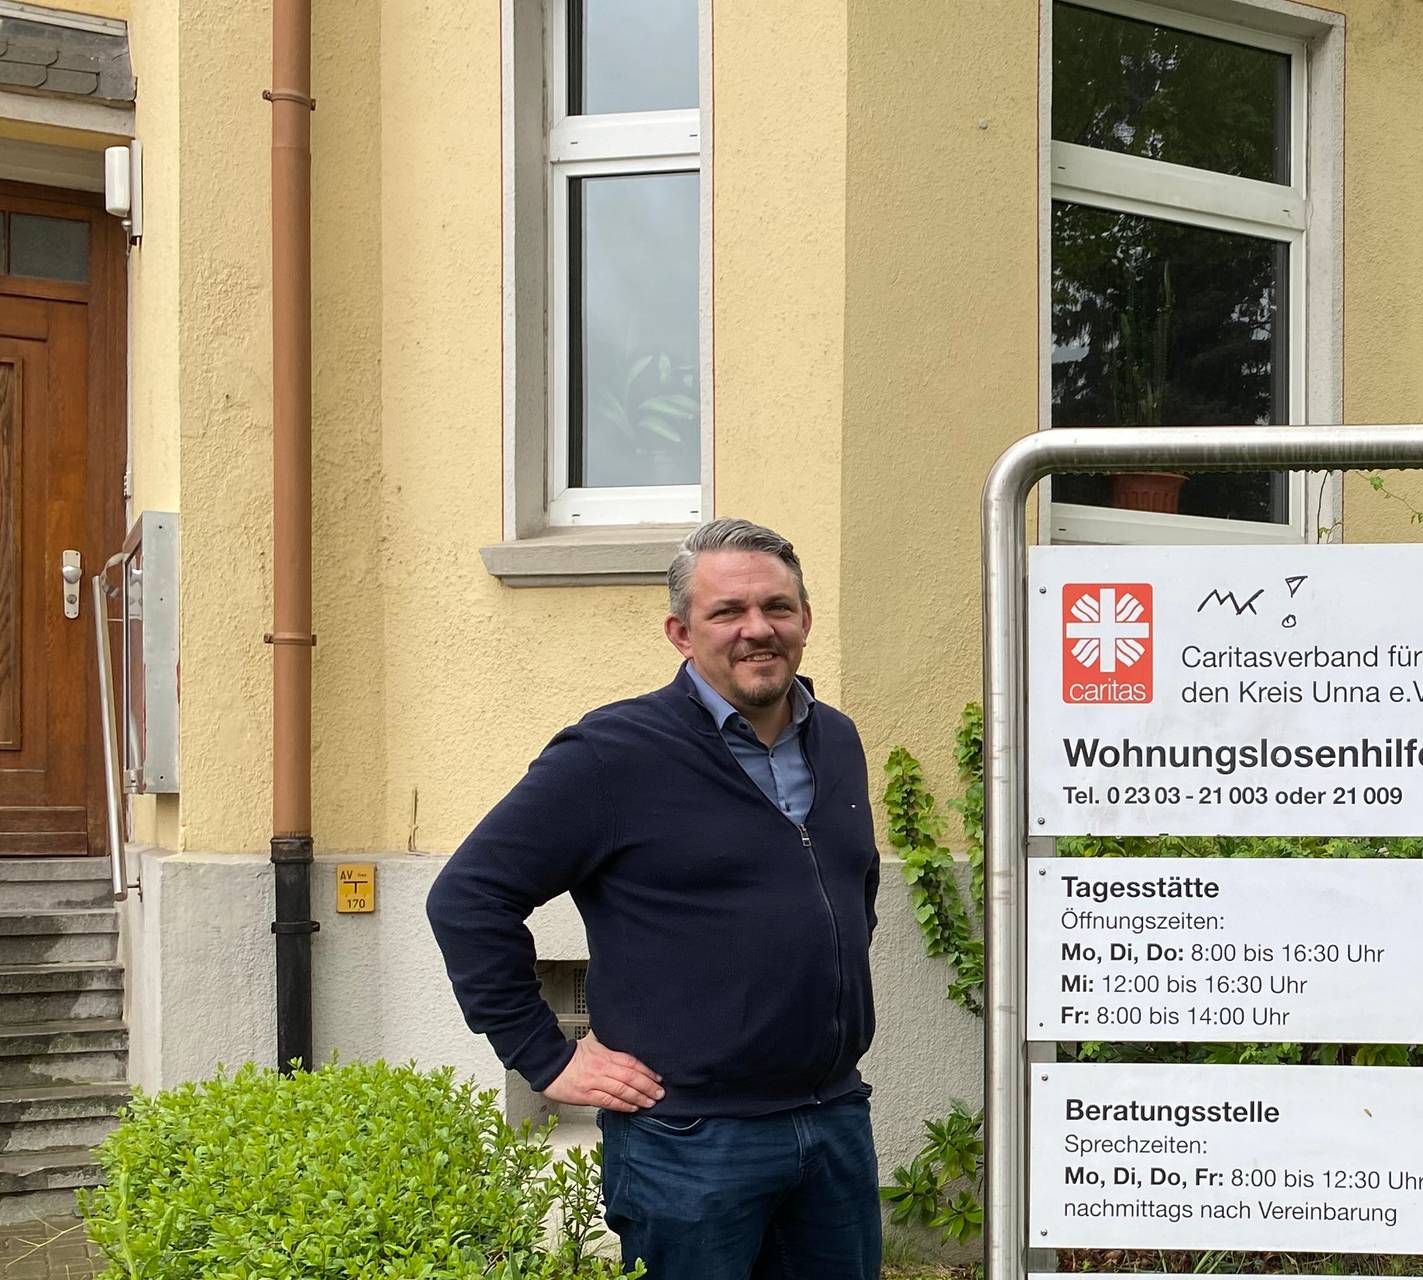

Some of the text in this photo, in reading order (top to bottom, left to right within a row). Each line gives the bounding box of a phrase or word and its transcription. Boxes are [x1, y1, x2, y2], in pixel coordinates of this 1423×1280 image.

[1181, 644, 1423, 668] Caritasverband für
[1068, 678, 1147, 703] caritas
[1181, 680, 1229, 704] den
[1239, 680, 1303, 704] Kreis
[1312, 680, 1381, 704] Unna
[1062, 786, 1100, 805] Tel.
[1275, 786, 1327, 805] oder
[1060, 875, 1220, 902] Tagesstätte
[347, 898, 366, 909] 170
[1061, 908, 1225, 933] Öffnungszeiten:
[1061, 942, 1385, 965] Mo, Di, Do: 8:00 bis 16:30 Uhr
[1061, 974, 1308, 994] Mi: 12:00 bis 16:30 Uhr
[1061, 1006, 1291, 1026] Fr: 8:00 bis 14:00 Uhr
[1065, 1098, 1281, 1126] Beratungsstelle
[1064, 1133, 1208, 1158] Sprechzeiten:
[1064, 1166, 1106, 1188] Mo,
[1113, 1166, 1142, 1189] Di,
[1150, 1167, 1188, 1190] Do,
[1195, 1167, 1225, 1187] Fr:
[1231, 1168, 1277, 1188] 8:00
[1284, 1169, 1315, 1188] bis
[1321, 1170, 1380, 1190] 12:30
[1064, 1199, 1397, 1227] nachmittags nach Vereinbarung
